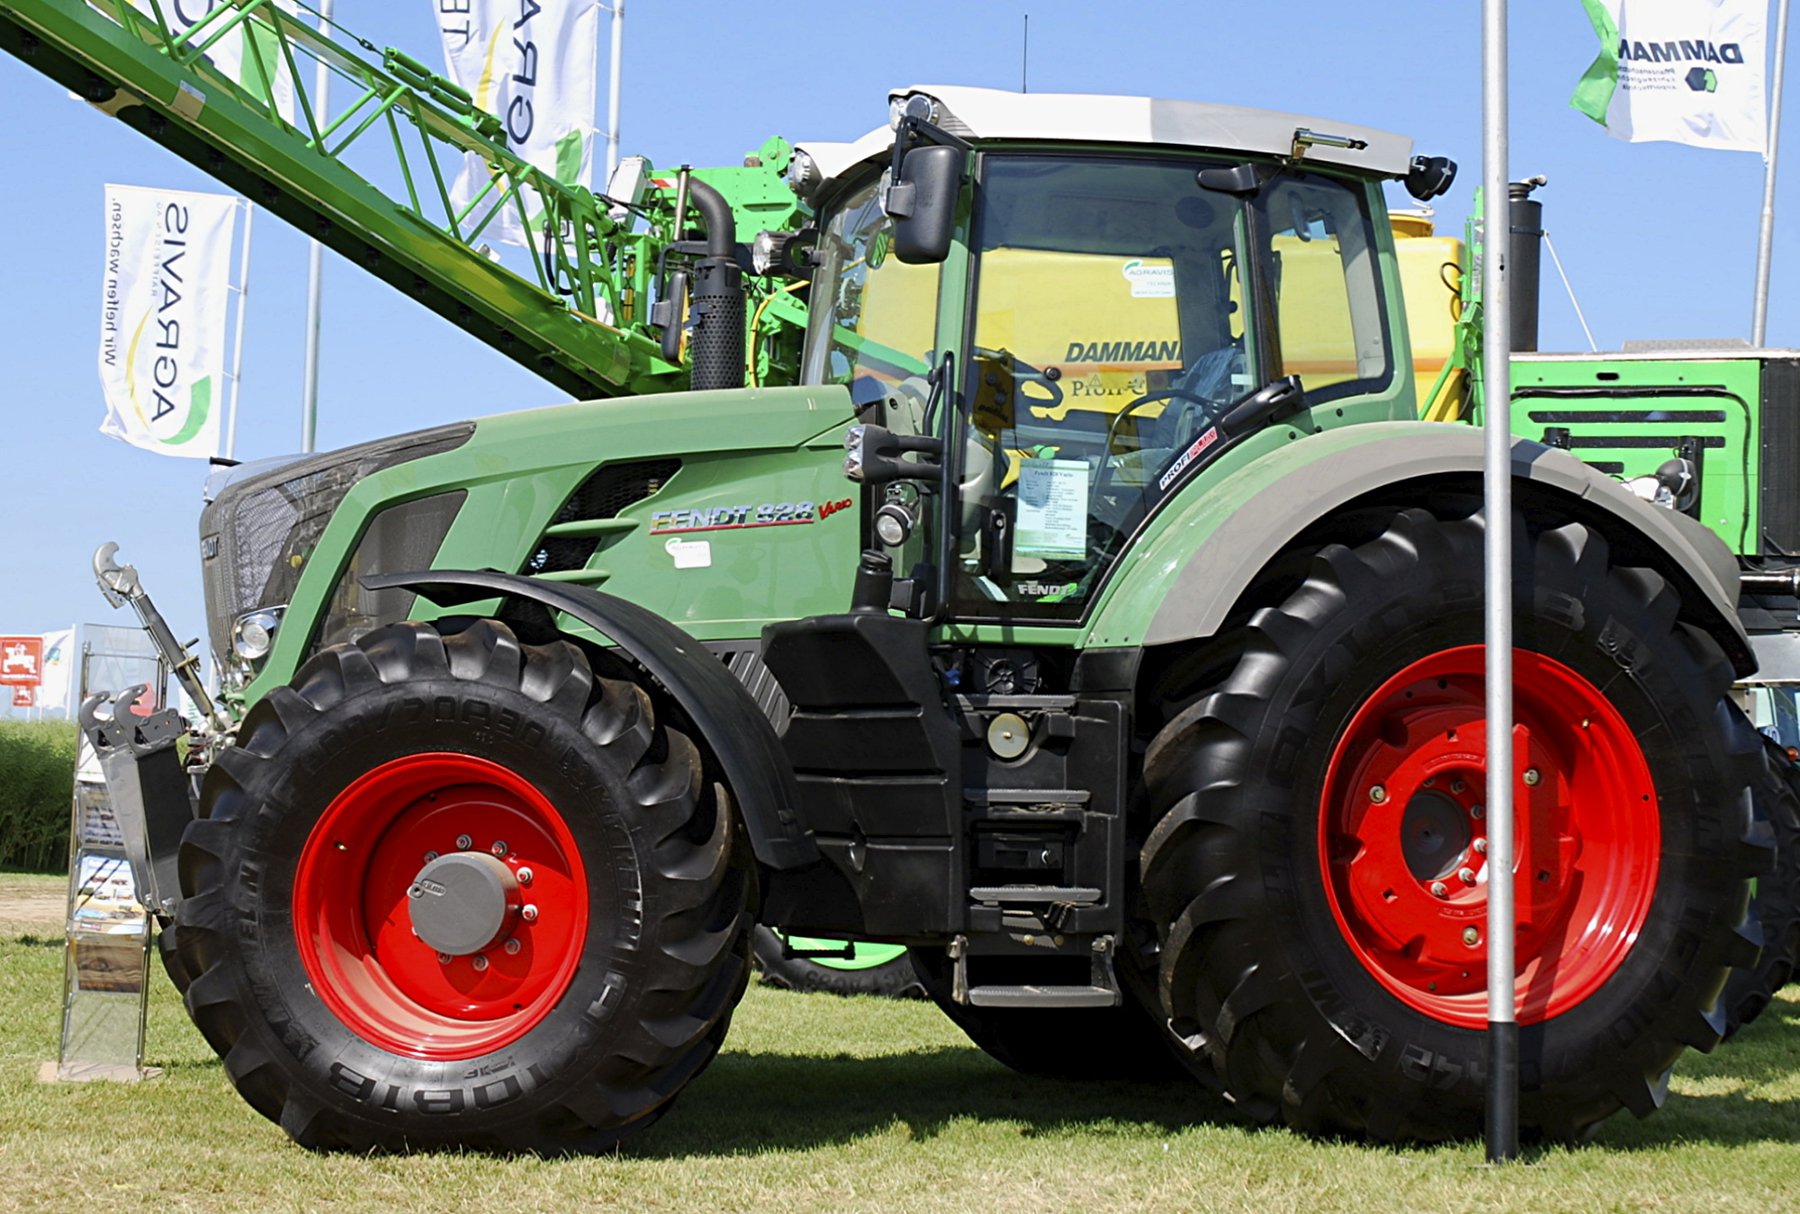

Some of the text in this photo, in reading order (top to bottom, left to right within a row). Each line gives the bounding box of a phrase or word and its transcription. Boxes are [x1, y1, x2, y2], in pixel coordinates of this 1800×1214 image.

[1064, 341, 1183, 363] DAMMAN
[1161, 452, 1191, 487] PROFI
[651, 506, 752, 531] FENDT
[755, 501, 815, 524] 828
